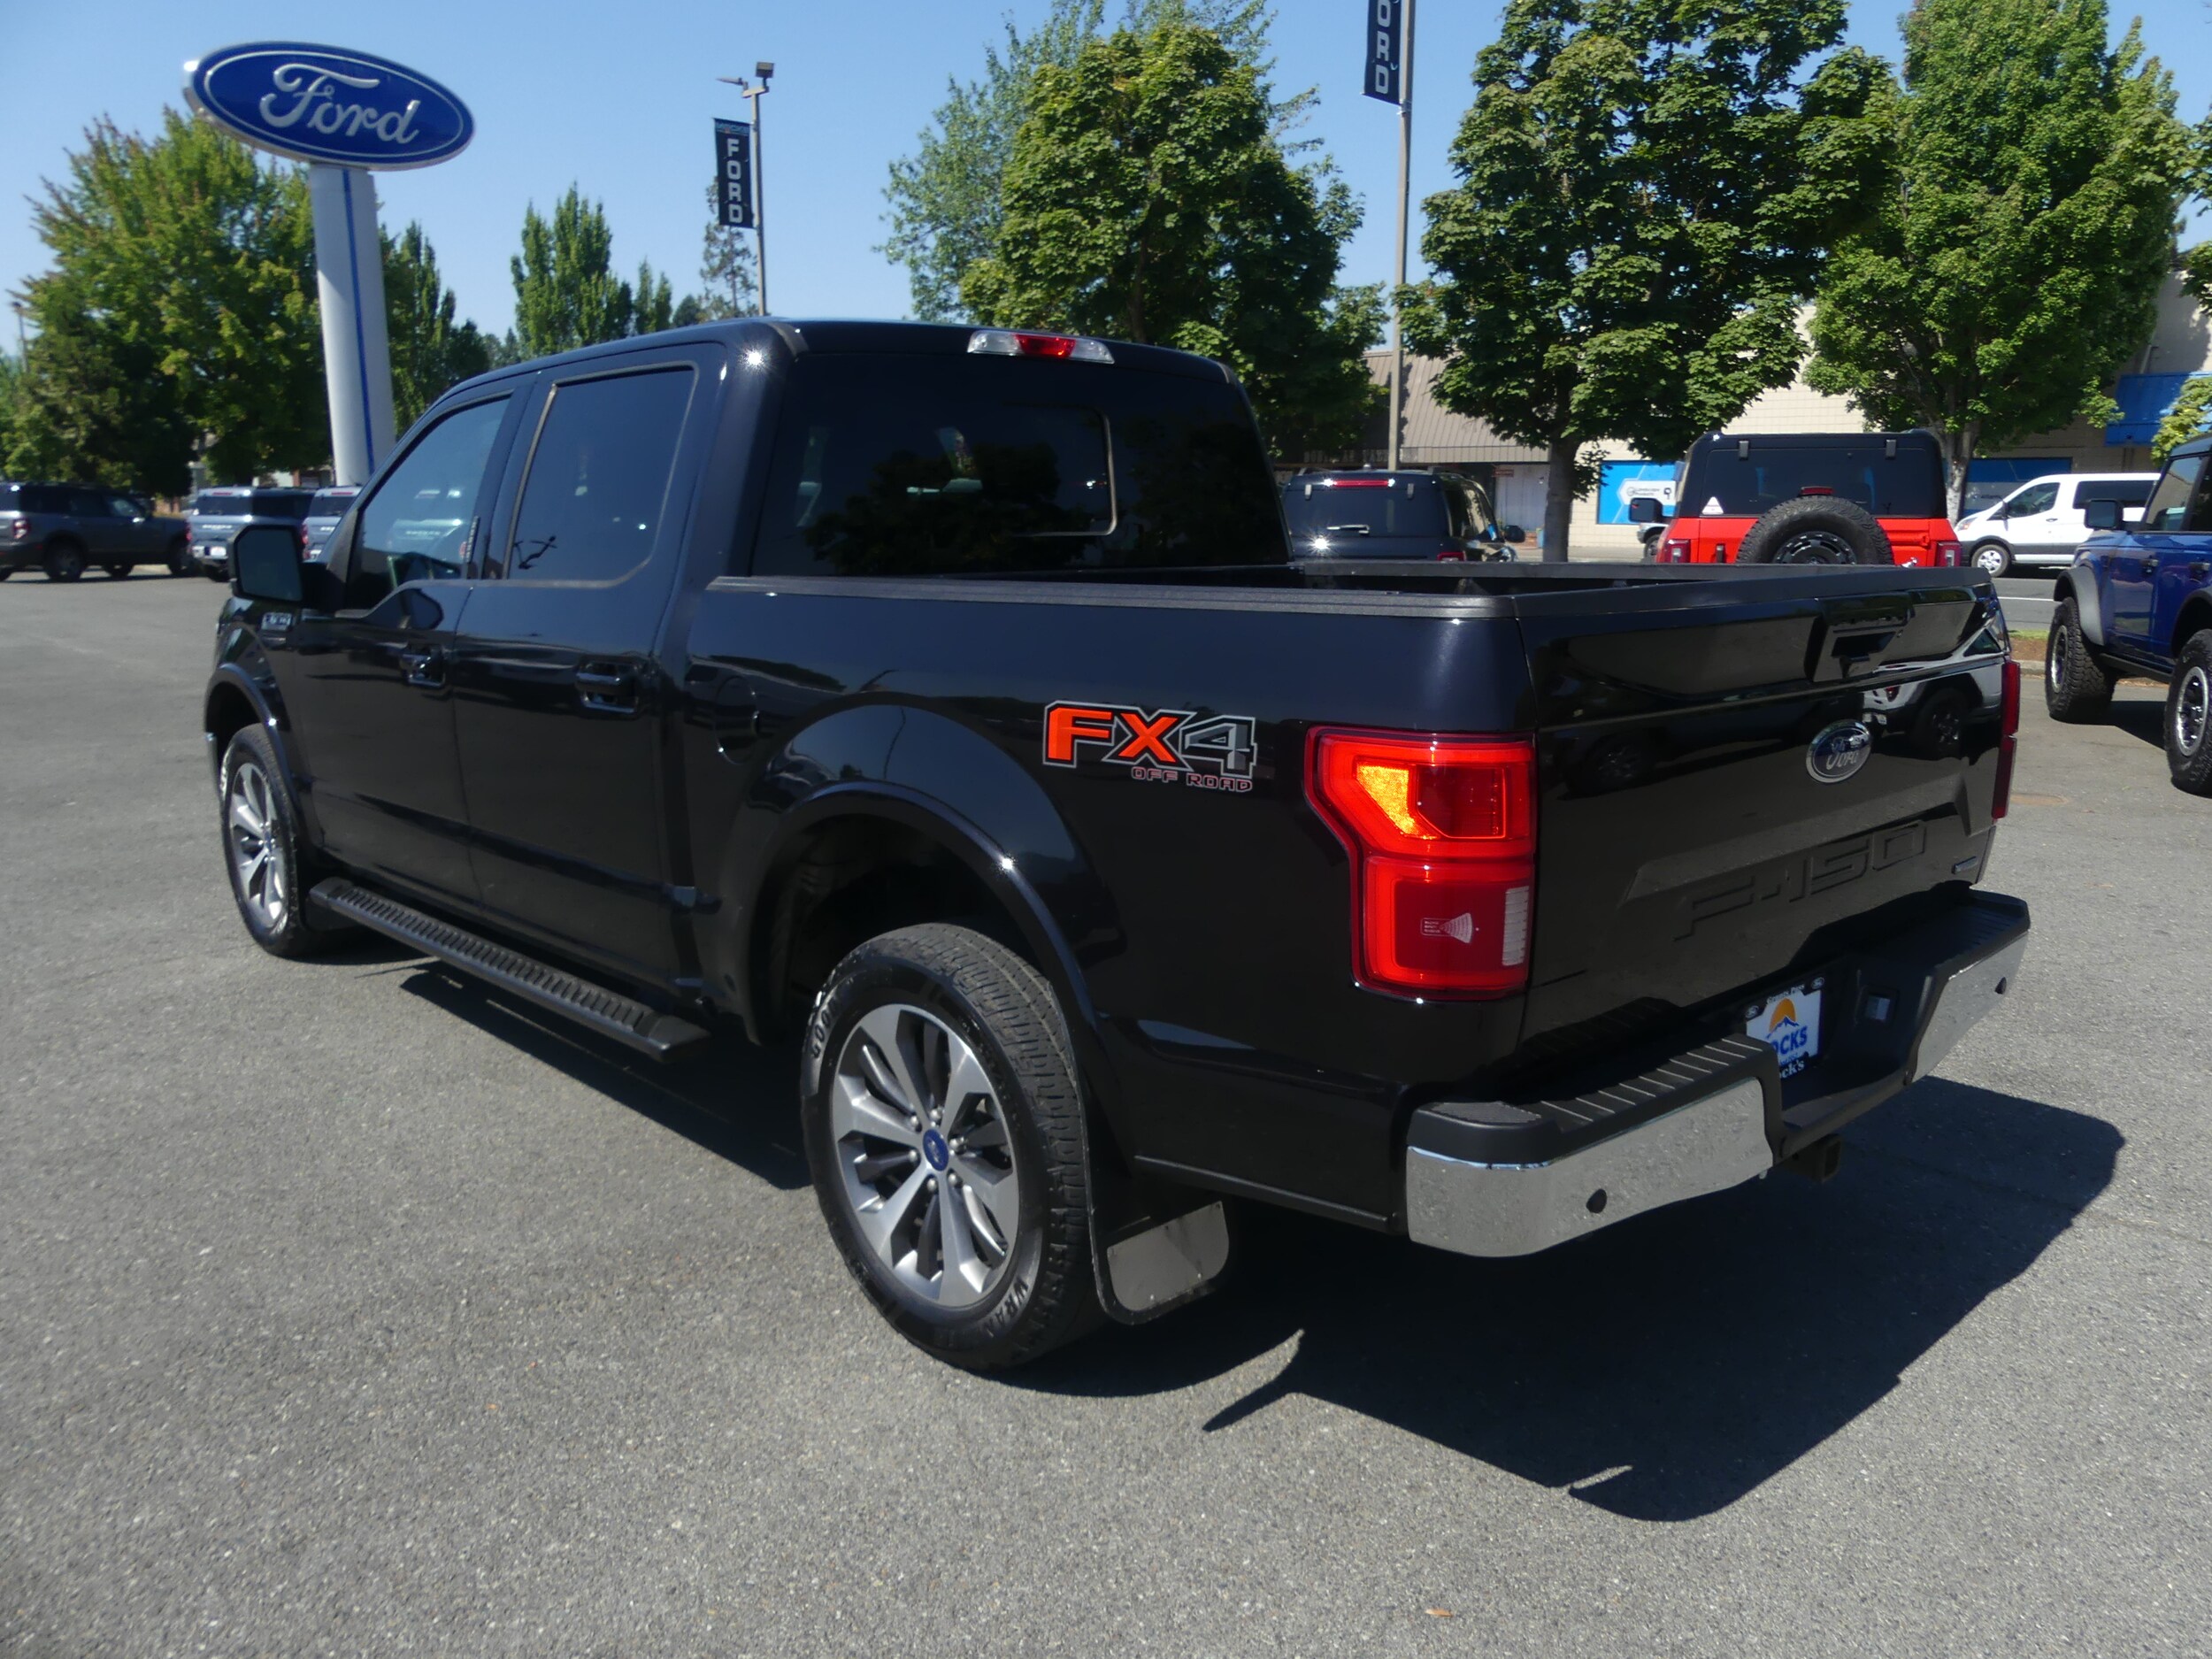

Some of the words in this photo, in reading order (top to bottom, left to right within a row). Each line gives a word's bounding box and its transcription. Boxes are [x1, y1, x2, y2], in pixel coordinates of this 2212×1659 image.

[259, 63, 421, 144] Ford
[726, 138, 743, 224] FORD
[1042, 700, 1257, 779] FX4
[1131, 766, 1179, 783] OFF
[1186, 772, 1254, 793] ROAD
[1671, 820, 1928, 941] F-150
